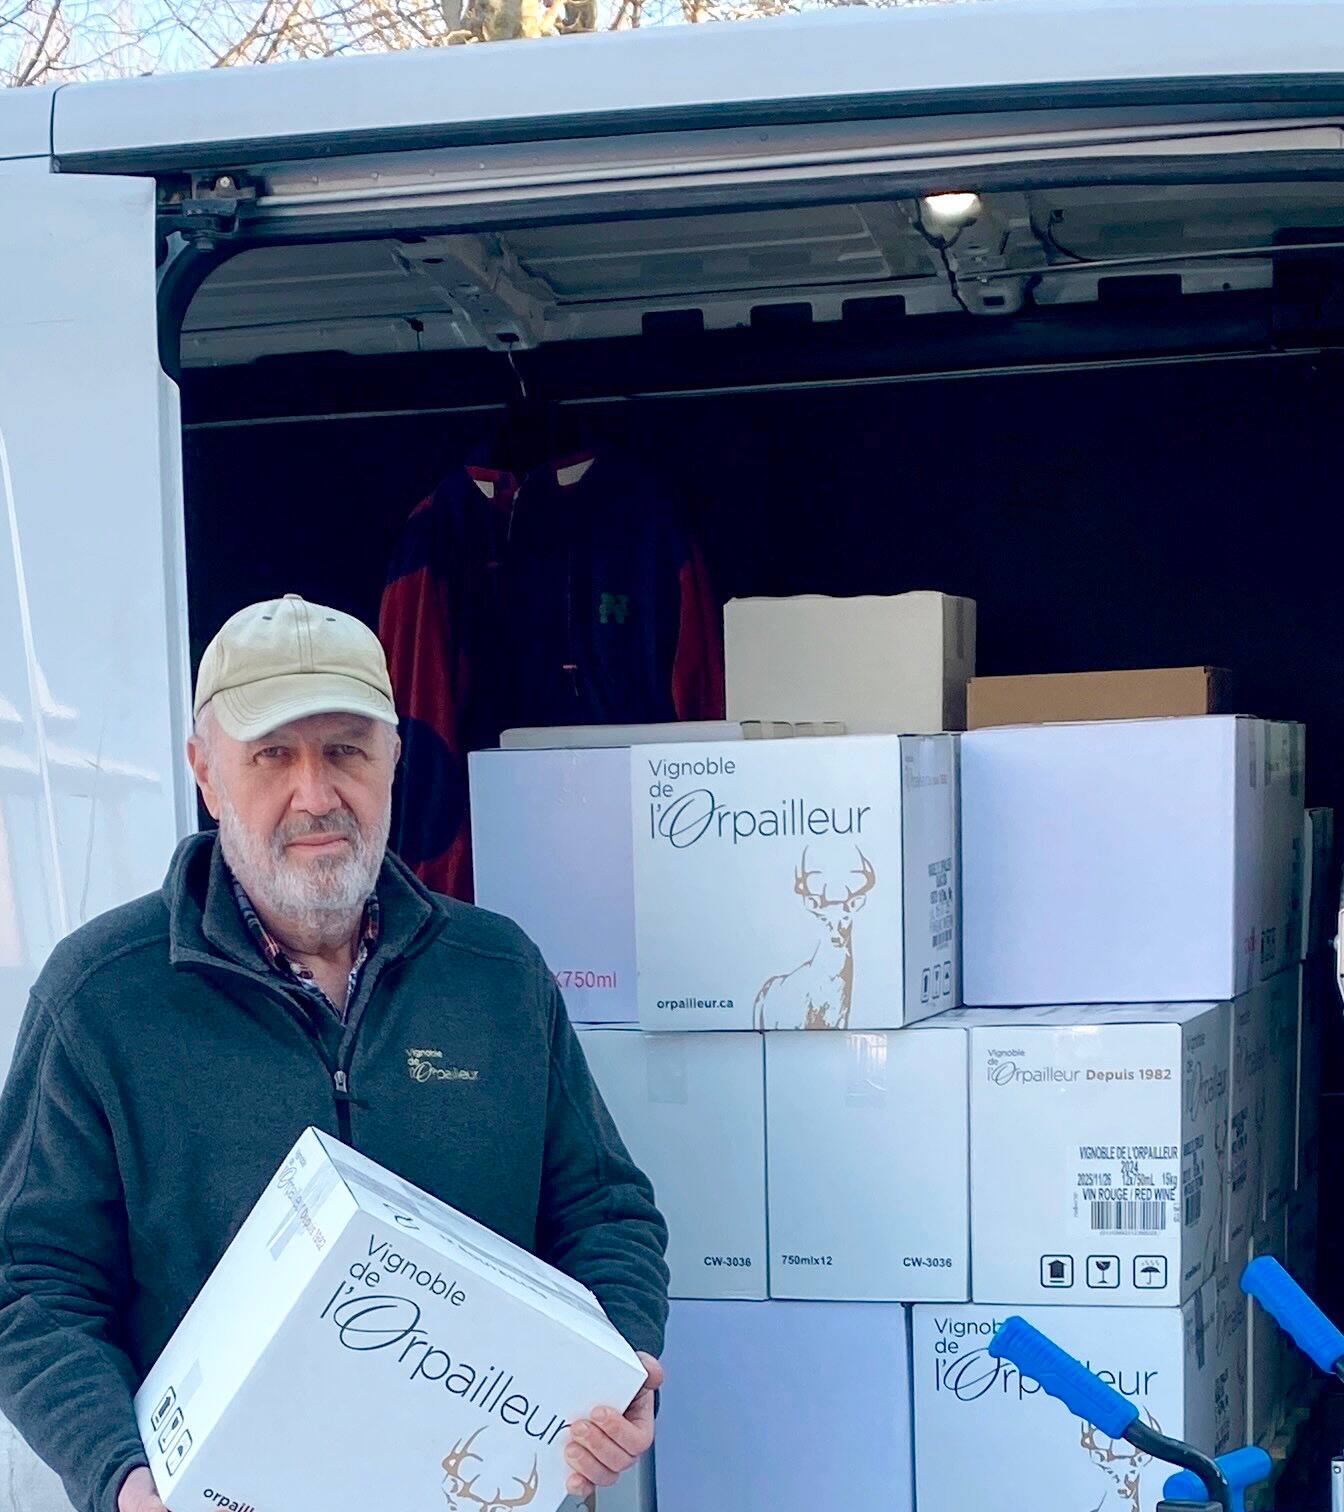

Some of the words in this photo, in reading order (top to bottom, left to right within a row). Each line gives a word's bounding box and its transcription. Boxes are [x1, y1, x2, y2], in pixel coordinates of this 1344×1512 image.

[648, 757, 736, 779] Vignoble
[649, 781, 674, 798] de
[650, 788, 871, 849] l'Orpailleur
[657, 998, 734, 1011] orpailleur.ca
[987, 1049, 1025, 1058] Vignoble
[987, 1057, 999, 1065] de
[987, 1061, 1080, 1086] l'Orpailleur
[1086, 1069, 1135, 1082] Depuis
[1139, 1069, 1172, 1080] 1982
[1079, 1146, 1115, 1159] VIGNOBLE
[1117, 1146, 1126, 1159] DE
[1127, 1146, 1178, 1159] L'ORPAILLEUR
[1082, 1188, 1096, 1200] VIN
[1098, 1188, 1128, 1200] ROUGE
[1135, 1188, 1153, 1200] RED
[1154, 1188, 1175, 1200] WINE
[367, 1234, 466, 1306] Vignoble
[704, 1256, 752, 1267] CW-3036
[781, 1255, 833, 1266] 750mlx12
[903, 1257, 952, 1268] CW-3036
[349, 1262, 380, 1287] de
[934, 1317, 1004, 1338] Vignob
[935, 1337, 958, 1354] de
[320, 1281, 571, 1445] l'Orpailleur
[935, 1348, 1158, 1401] l'Orpeur
